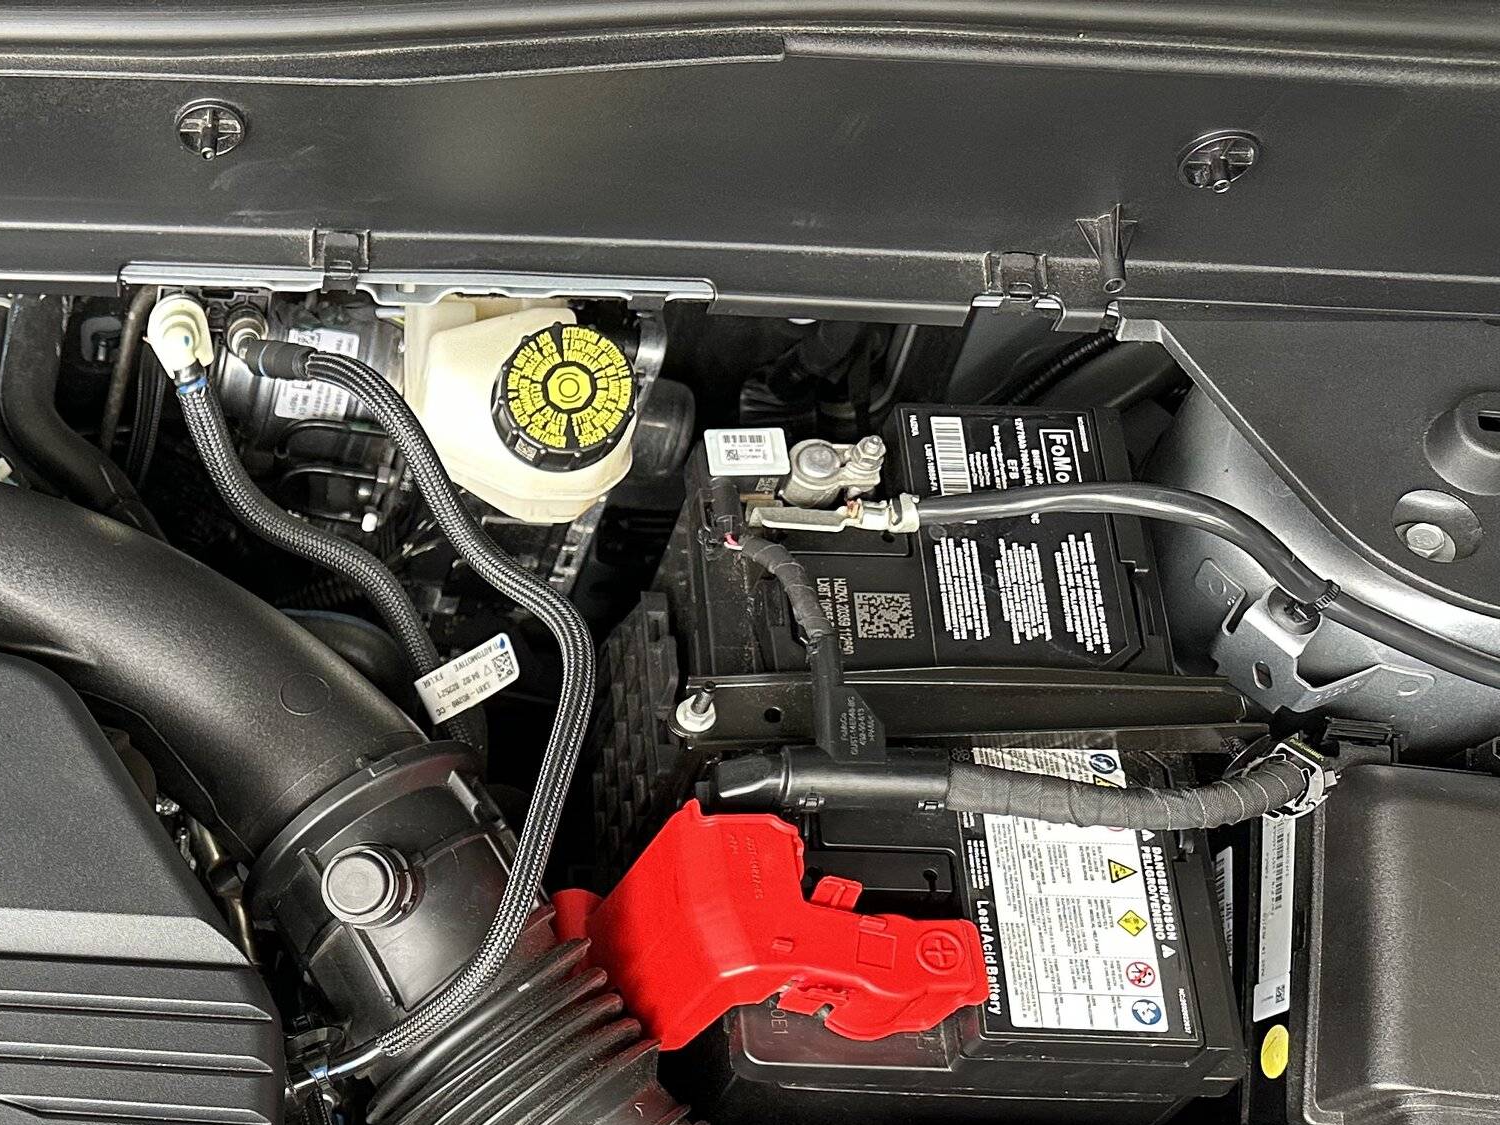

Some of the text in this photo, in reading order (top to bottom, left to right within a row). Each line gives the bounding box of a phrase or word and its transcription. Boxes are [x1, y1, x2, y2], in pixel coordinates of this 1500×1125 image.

[1007, 459, 1019, 479] EFB
[1048, 434, 1071, 483] FoMo
[836, 605, 851, 626] 20359
[453, 646, 492, 672] AUTOMOTIVE
[1141, 846, 1164, 940] PELIGRO/VENENO
[1152, 847, 1177, 941] DANGER/POISON
[976, 901, 993, 932] Lead
[981, 934, 997, 964] Acid
[987, 966, 1002, 1015] Battery
